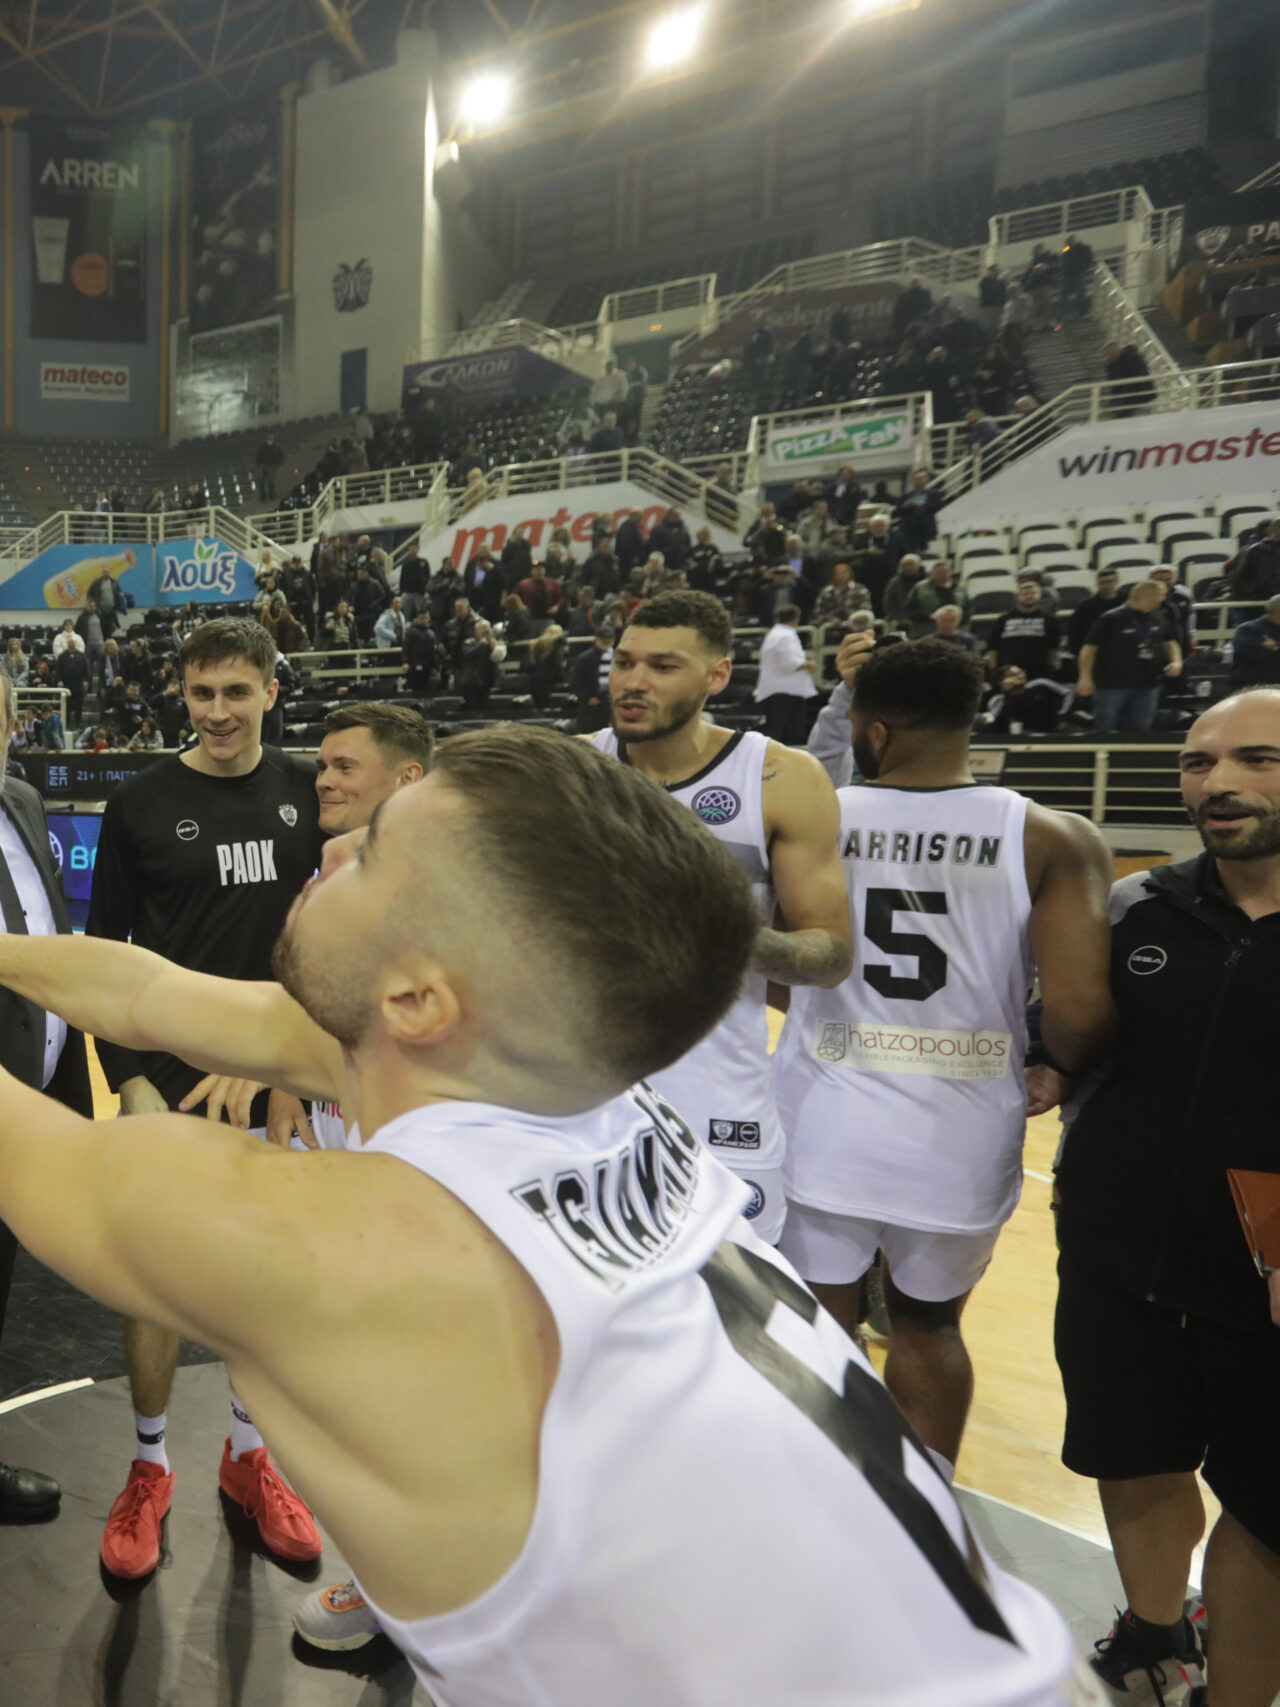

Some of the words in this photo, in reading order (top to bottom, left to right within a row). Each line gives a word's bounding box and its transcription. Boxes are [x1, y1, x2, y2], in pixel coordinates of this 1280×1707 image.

[44, 366, 127, 386] mateco
[162, 554, 237, 593] λουξ
[77, 769, 95, 781] 21+
[215, 839, 278, 886] PAOK
[839, 827, 1004, 869] ARRISON
[863, 888, 948, 1001] 5
[847, 1023, 1006, 1056] hatzopoulos
